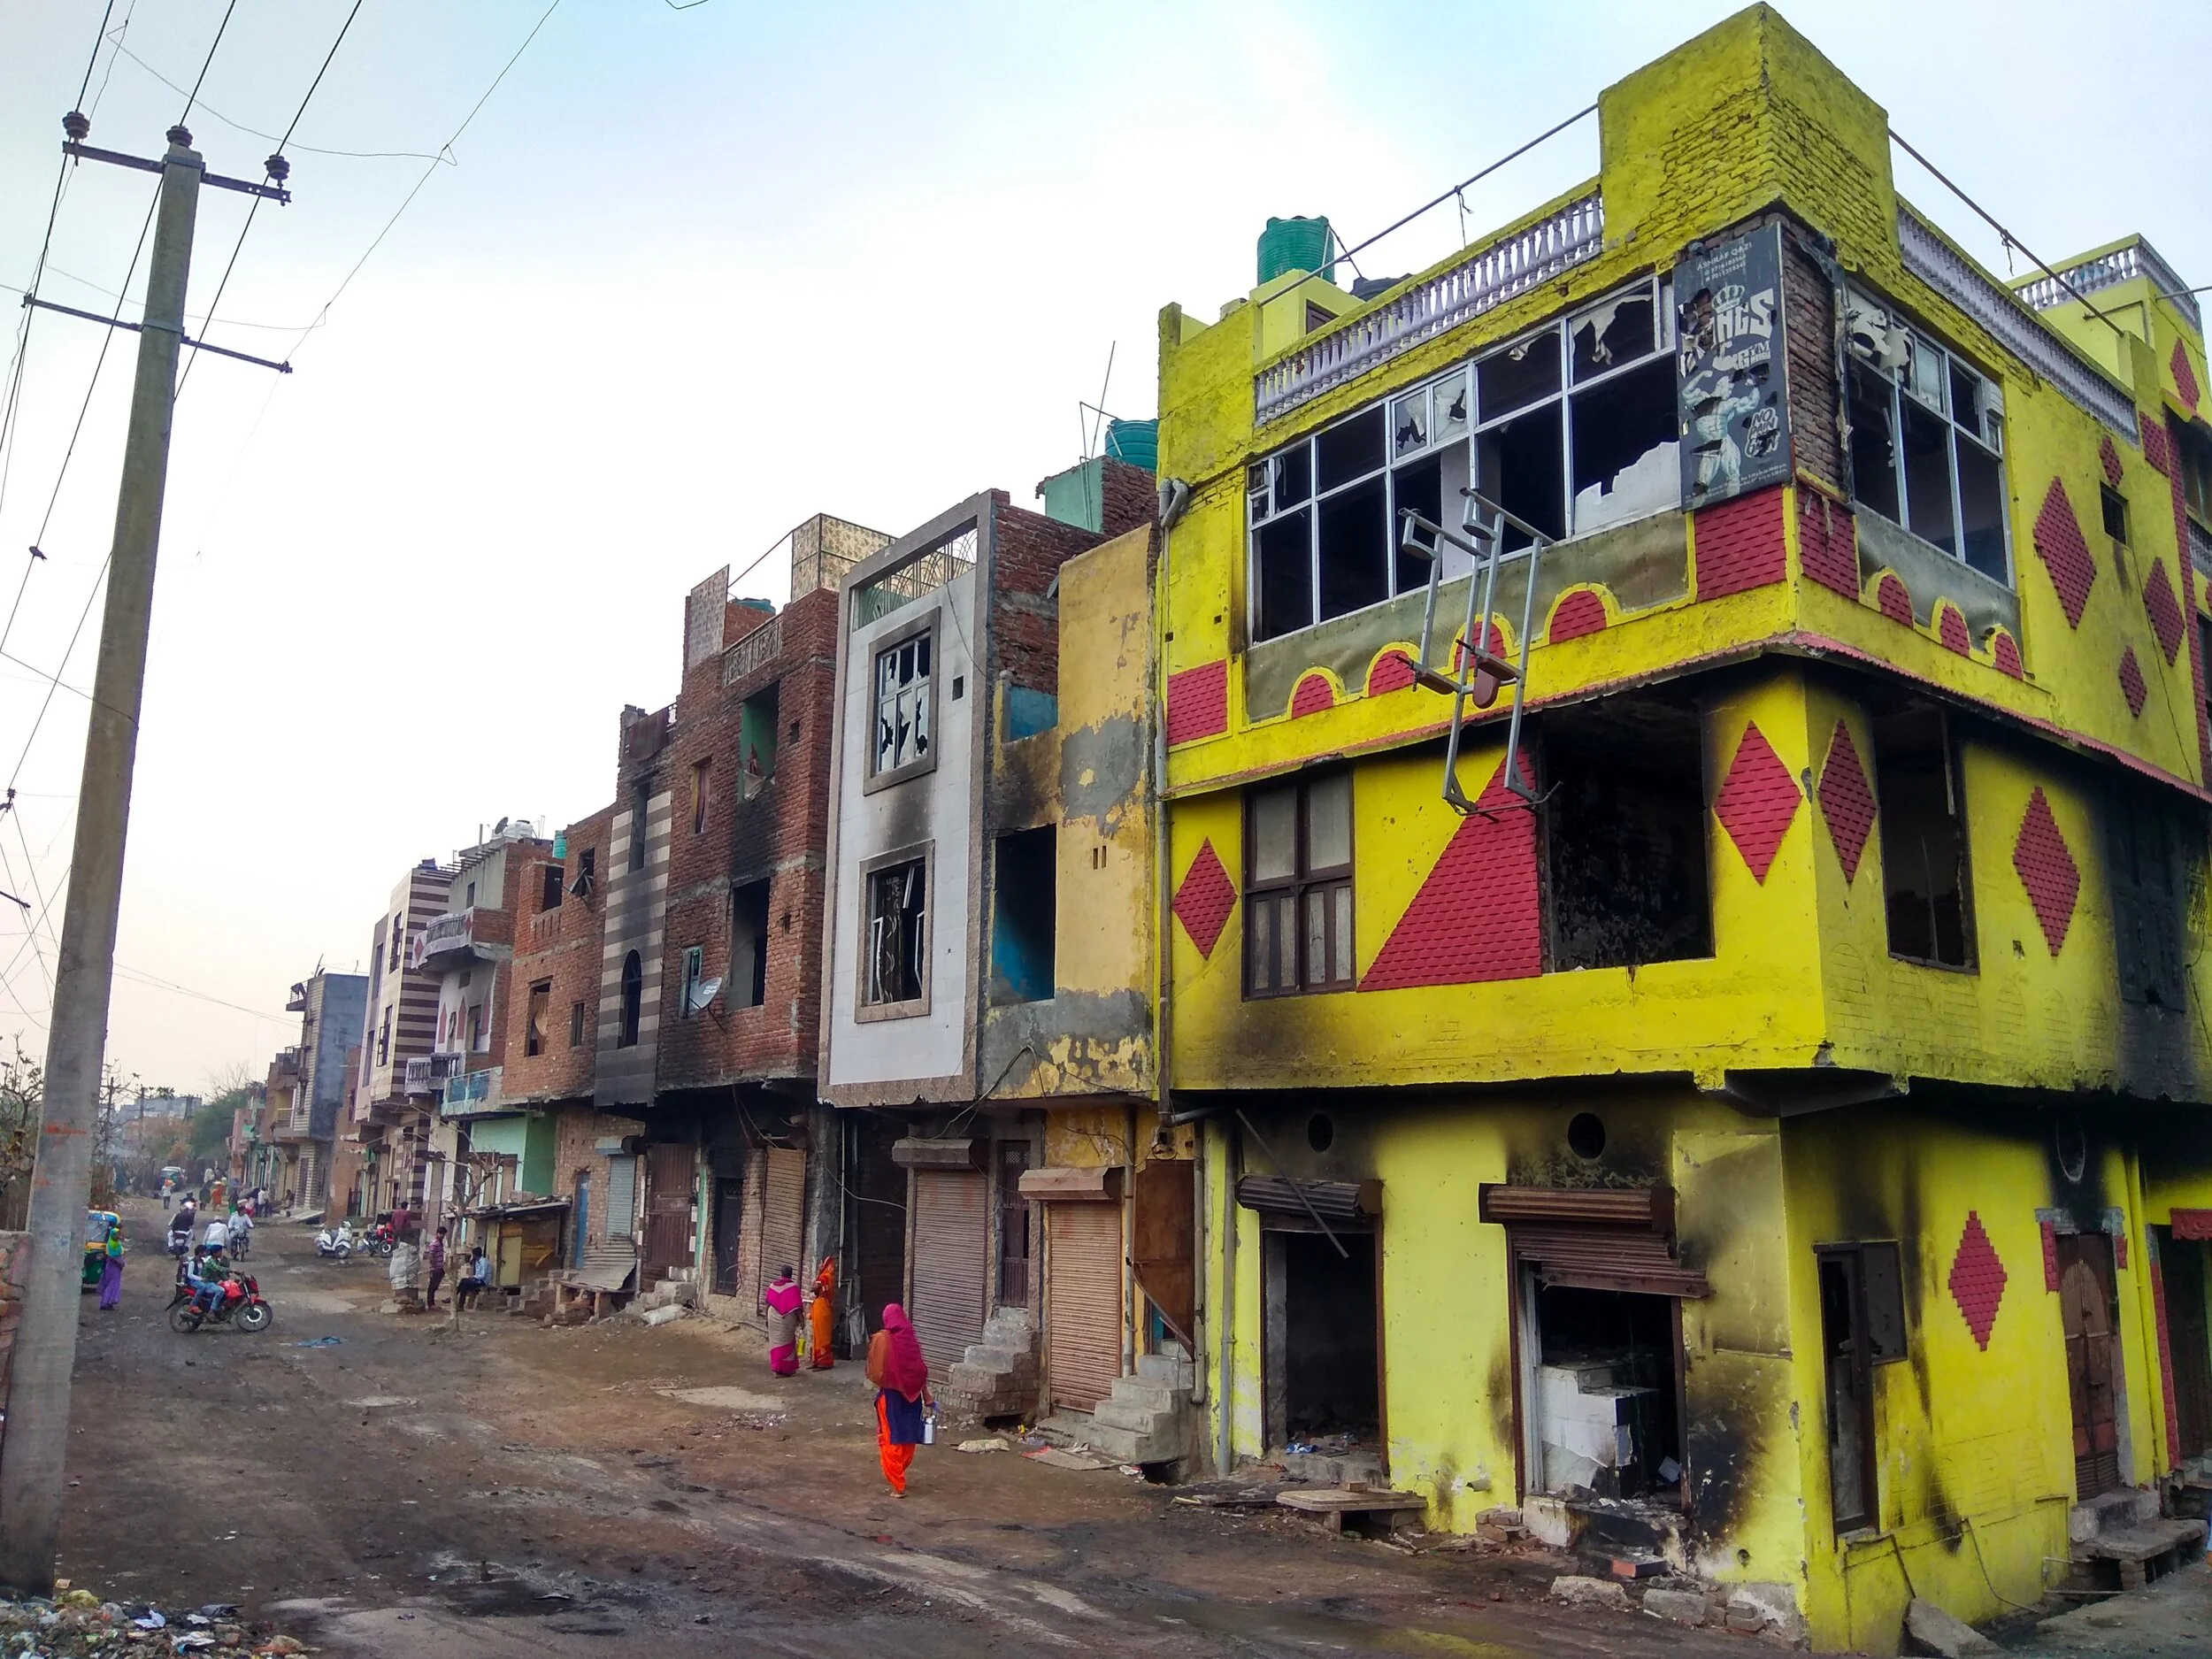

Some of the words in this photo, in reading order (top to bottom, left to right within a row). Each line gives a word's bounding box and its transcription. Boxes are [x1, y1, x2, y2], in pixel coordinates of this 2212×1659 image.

[1737, 340, 1770, 368] GYM
[1748, 417, 1775, 440] PAIN
[1753, 409, 1773, 426] NO
